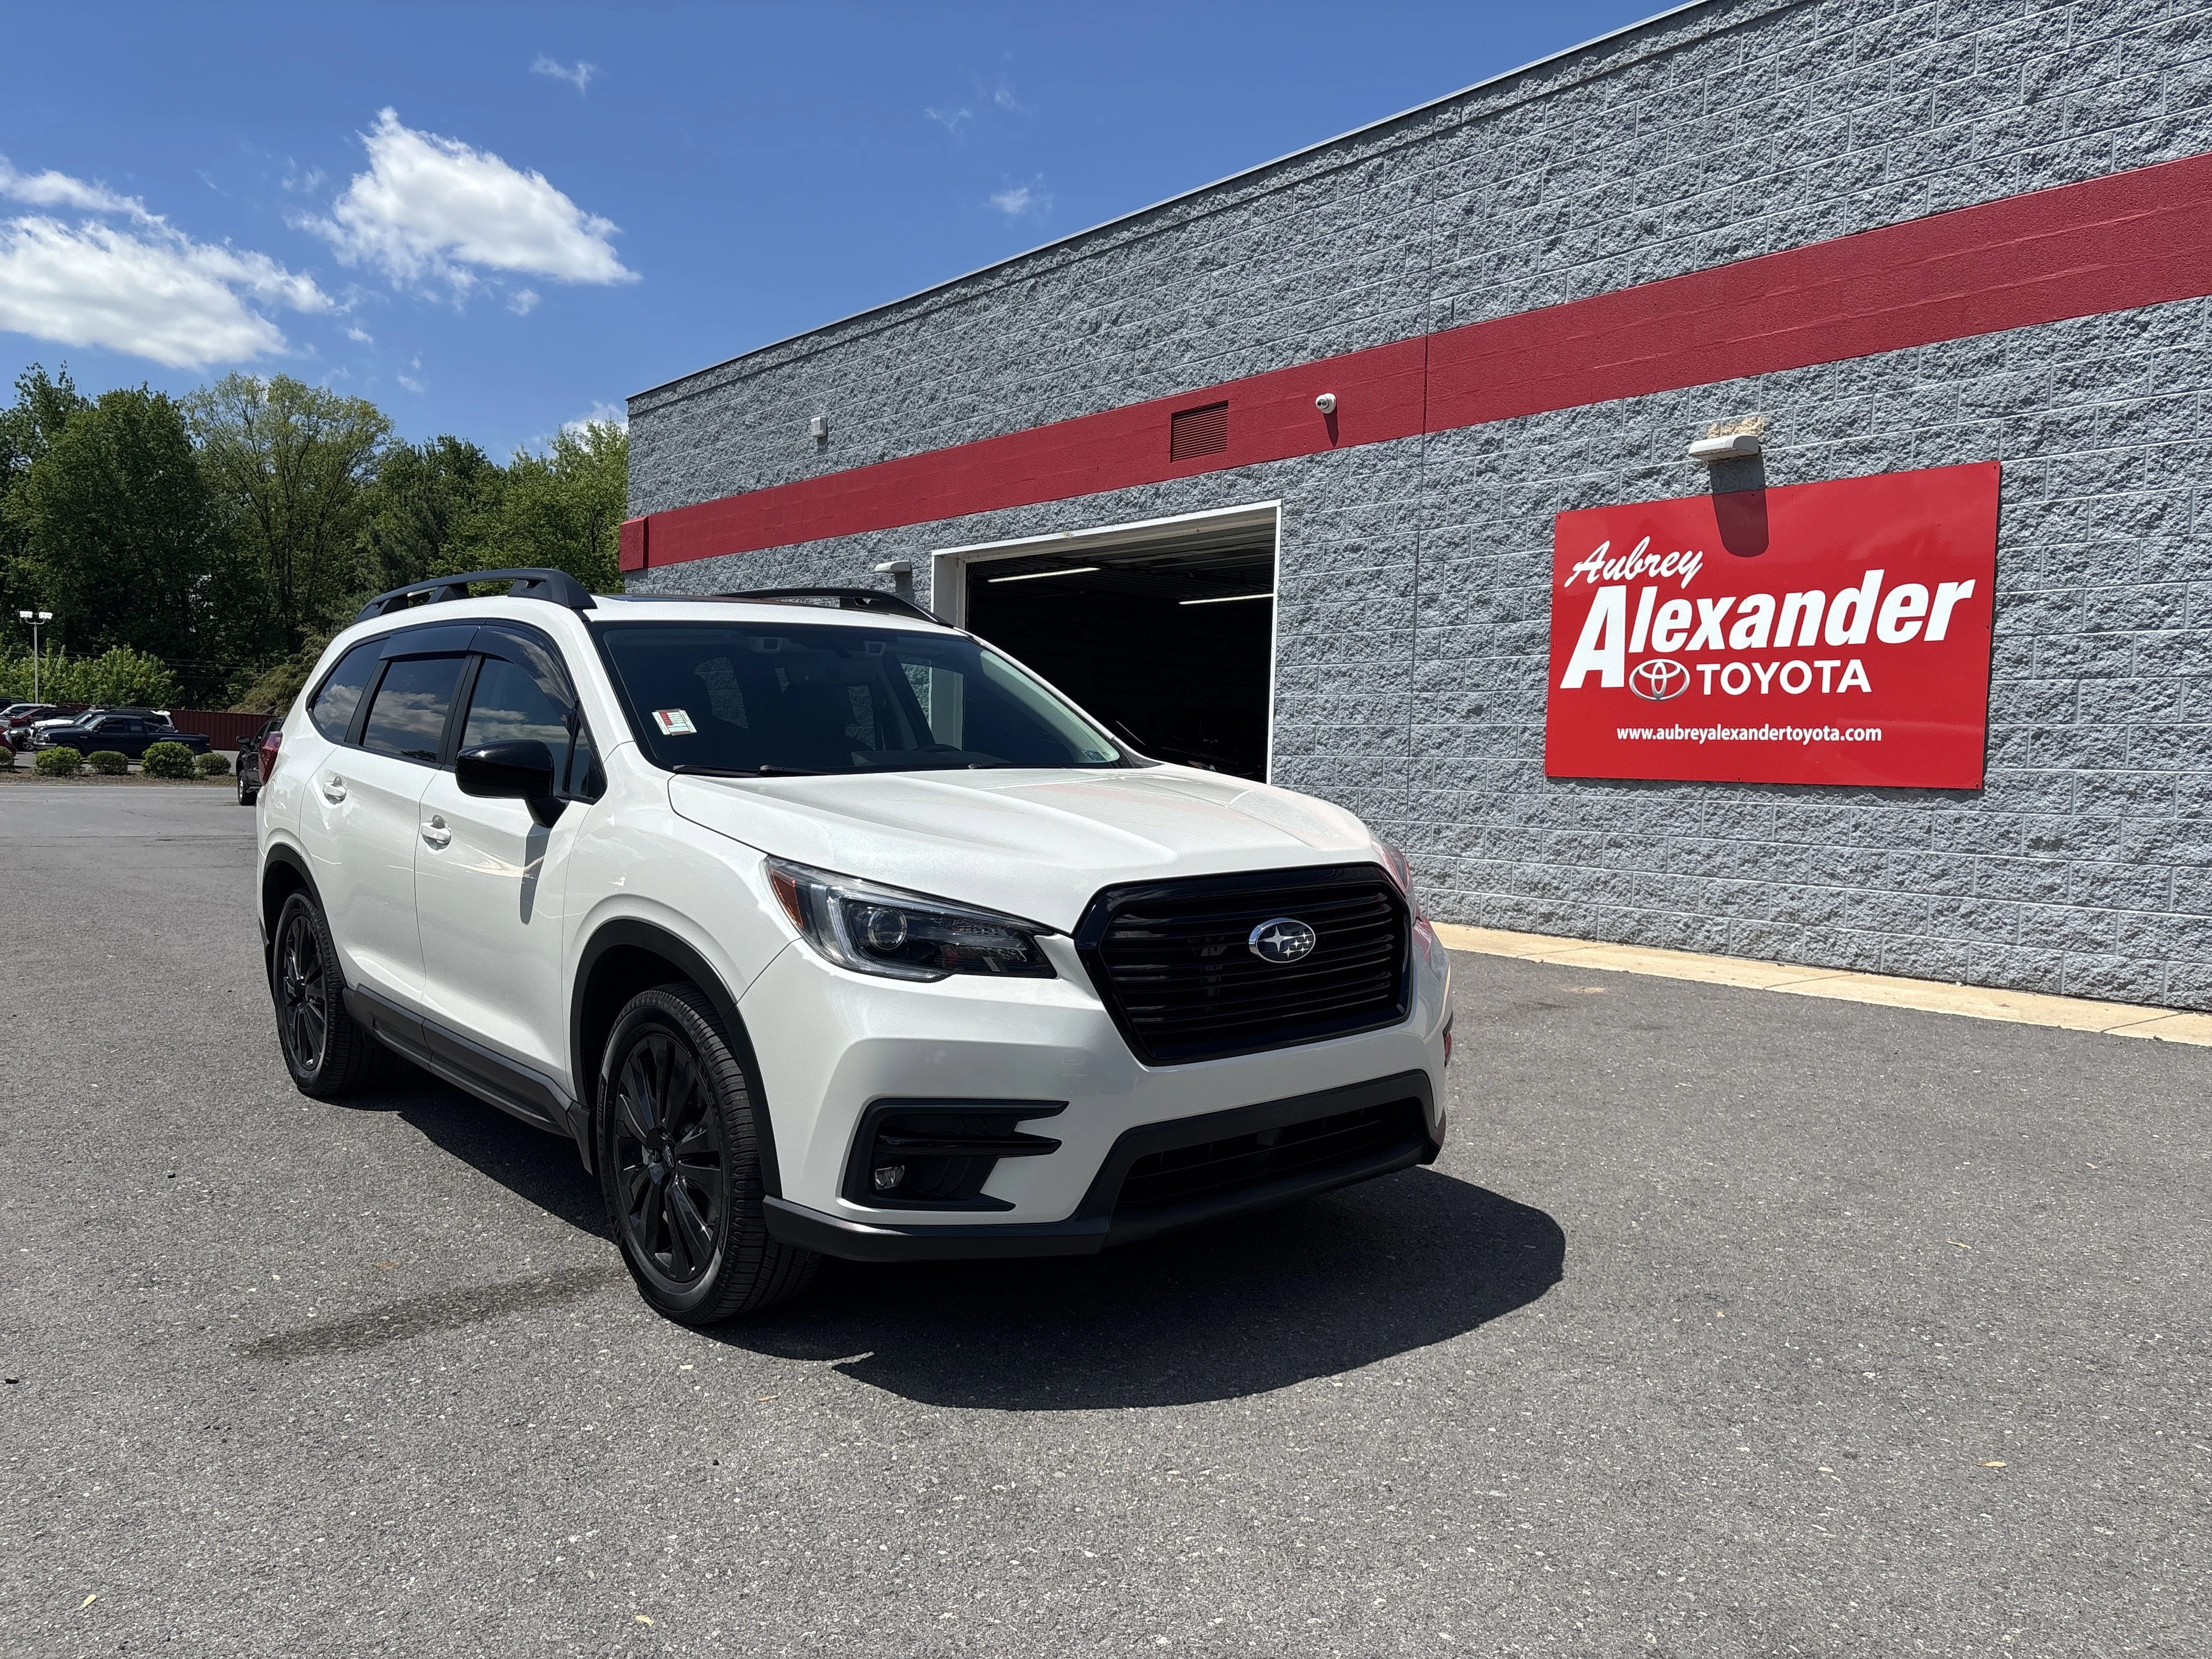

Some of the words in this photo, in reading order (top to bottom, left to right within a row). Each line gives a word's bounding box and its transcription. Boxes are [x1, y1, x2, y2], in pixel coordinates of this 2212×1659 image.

[1564, 536, 1703, 589] Aubrey
[1560, 569, 1976, 689] Alexander
[1696, 659, 1872, 695] TOYOTA
[1617, 723, 1881, 745] www.aubreyalexandertoyota.com
